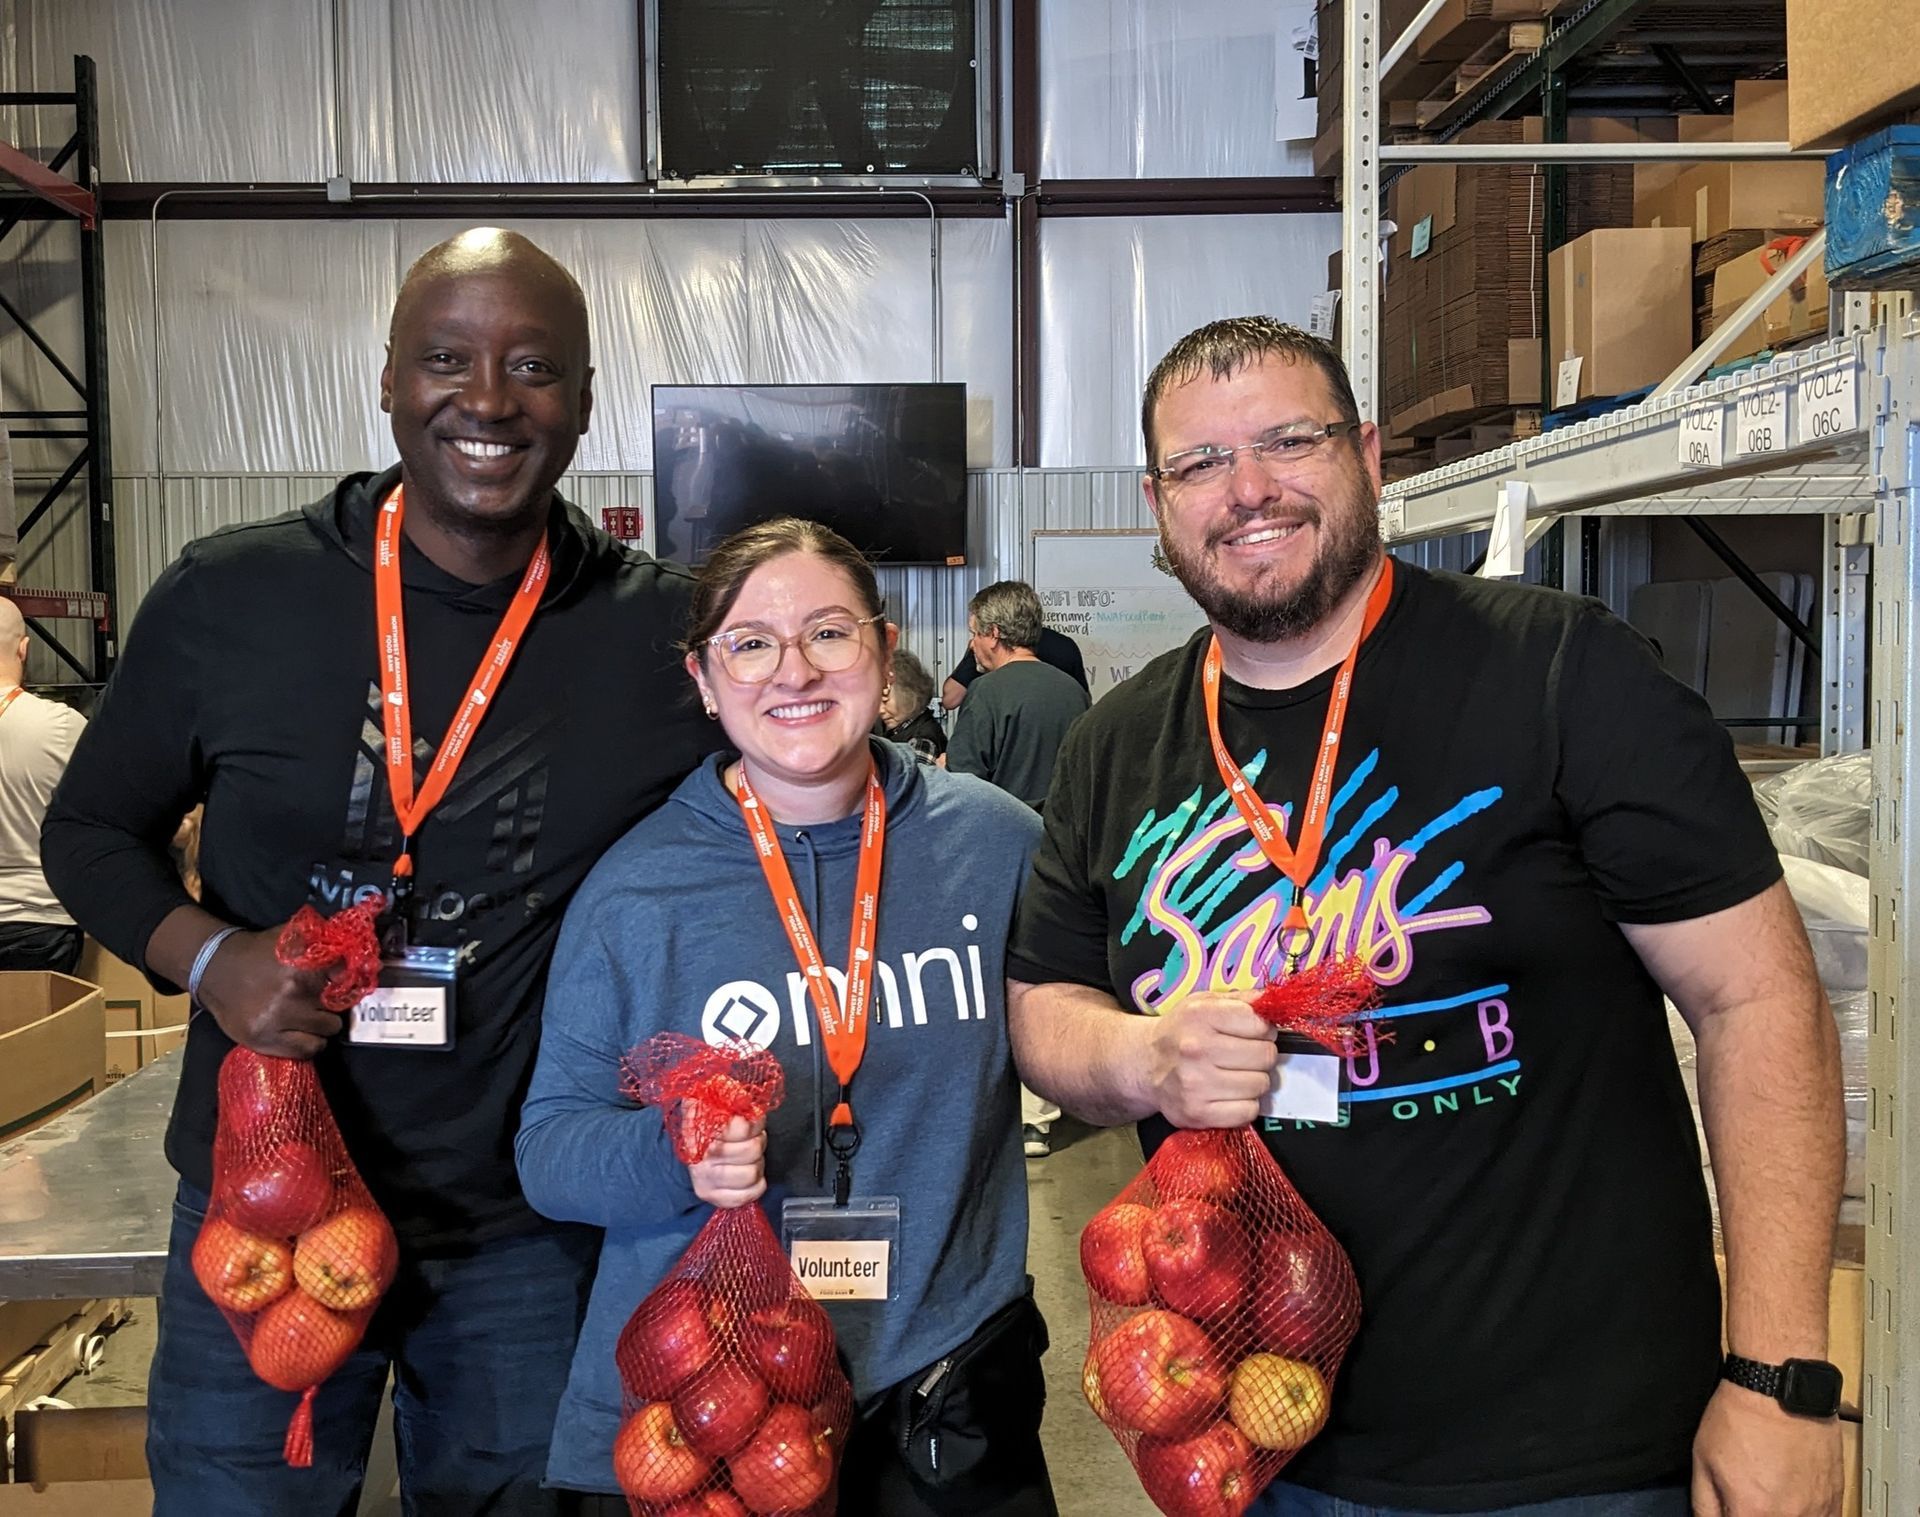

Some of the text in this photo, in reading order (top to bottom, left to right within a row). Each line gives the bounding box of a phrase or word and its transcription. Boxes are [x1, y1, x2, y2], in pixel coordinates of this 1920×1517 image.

[1804, 369, 1848, 402] VOL2-
[1742, 391, 1780, 418] VOL2-
[1685, 408, 1717, 431] VOL2-
[1812, 407, 1841, 437] 06C
[1748, 427, 1772, 451] 06B
[1689, 442, 1710, 464] 06A
[1309, 746, 1329, 824] NORTHWEST ARKANSAS
[1319, 764, 1331, 804] FOOD BANK
[787, 915, 799, 933] FOOD
[848, 961, 860, 1033] NORTHWEST ARKANSAS
[359, 1003, 437, 1022] Volunteer
[1392, 1075, 1521, 1120] ONLY
[798, 1257, 880, 1278] Volunteer
